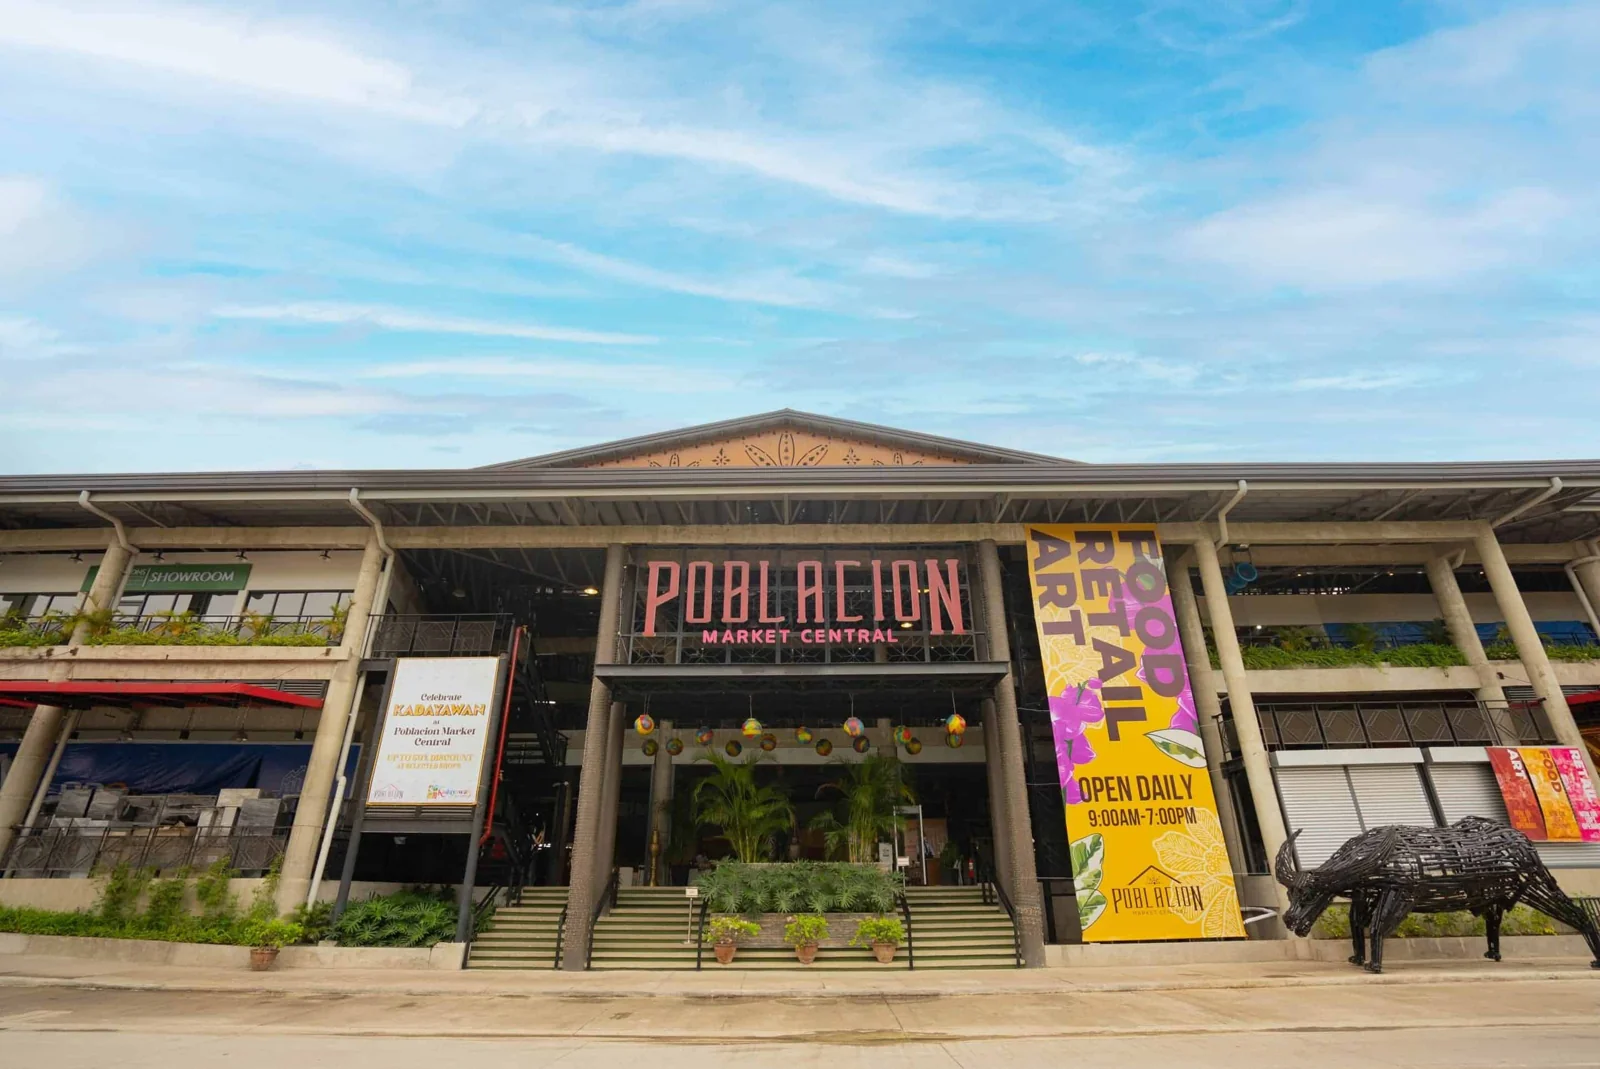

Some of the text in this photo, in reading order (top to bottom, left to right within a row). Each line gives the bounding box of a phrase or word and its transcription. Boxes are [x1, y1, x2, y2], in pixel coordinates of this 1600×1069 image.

[150, 571, 234, 583] SHOWROOM
[1030, 528, 1086, 646] ART
[642, 559, 966, 637] POBLACION
[1118, 531, 1186, 697] FOOD
[702, 628, 898, 644] MARKET CENTRAL
[1074, 531, 1147, 741] RETAIL
[393, 703, 486, 717] KADAYAWAN
[420, 693, 462, 701] Celebrate
[394, 727, 476, 736] Poblacion Market
[414, 738, 451, 746] Central
[1507, 749, 1528, 779] ART
[1540, 750, 1562, 792] FOOD
[1078, 774, 1193, 803] OPEN DAILY
[1088, 807, 1197, 827] 9:00AM-7:00PM
[1112, 886, 1204, 914] POBLACION
